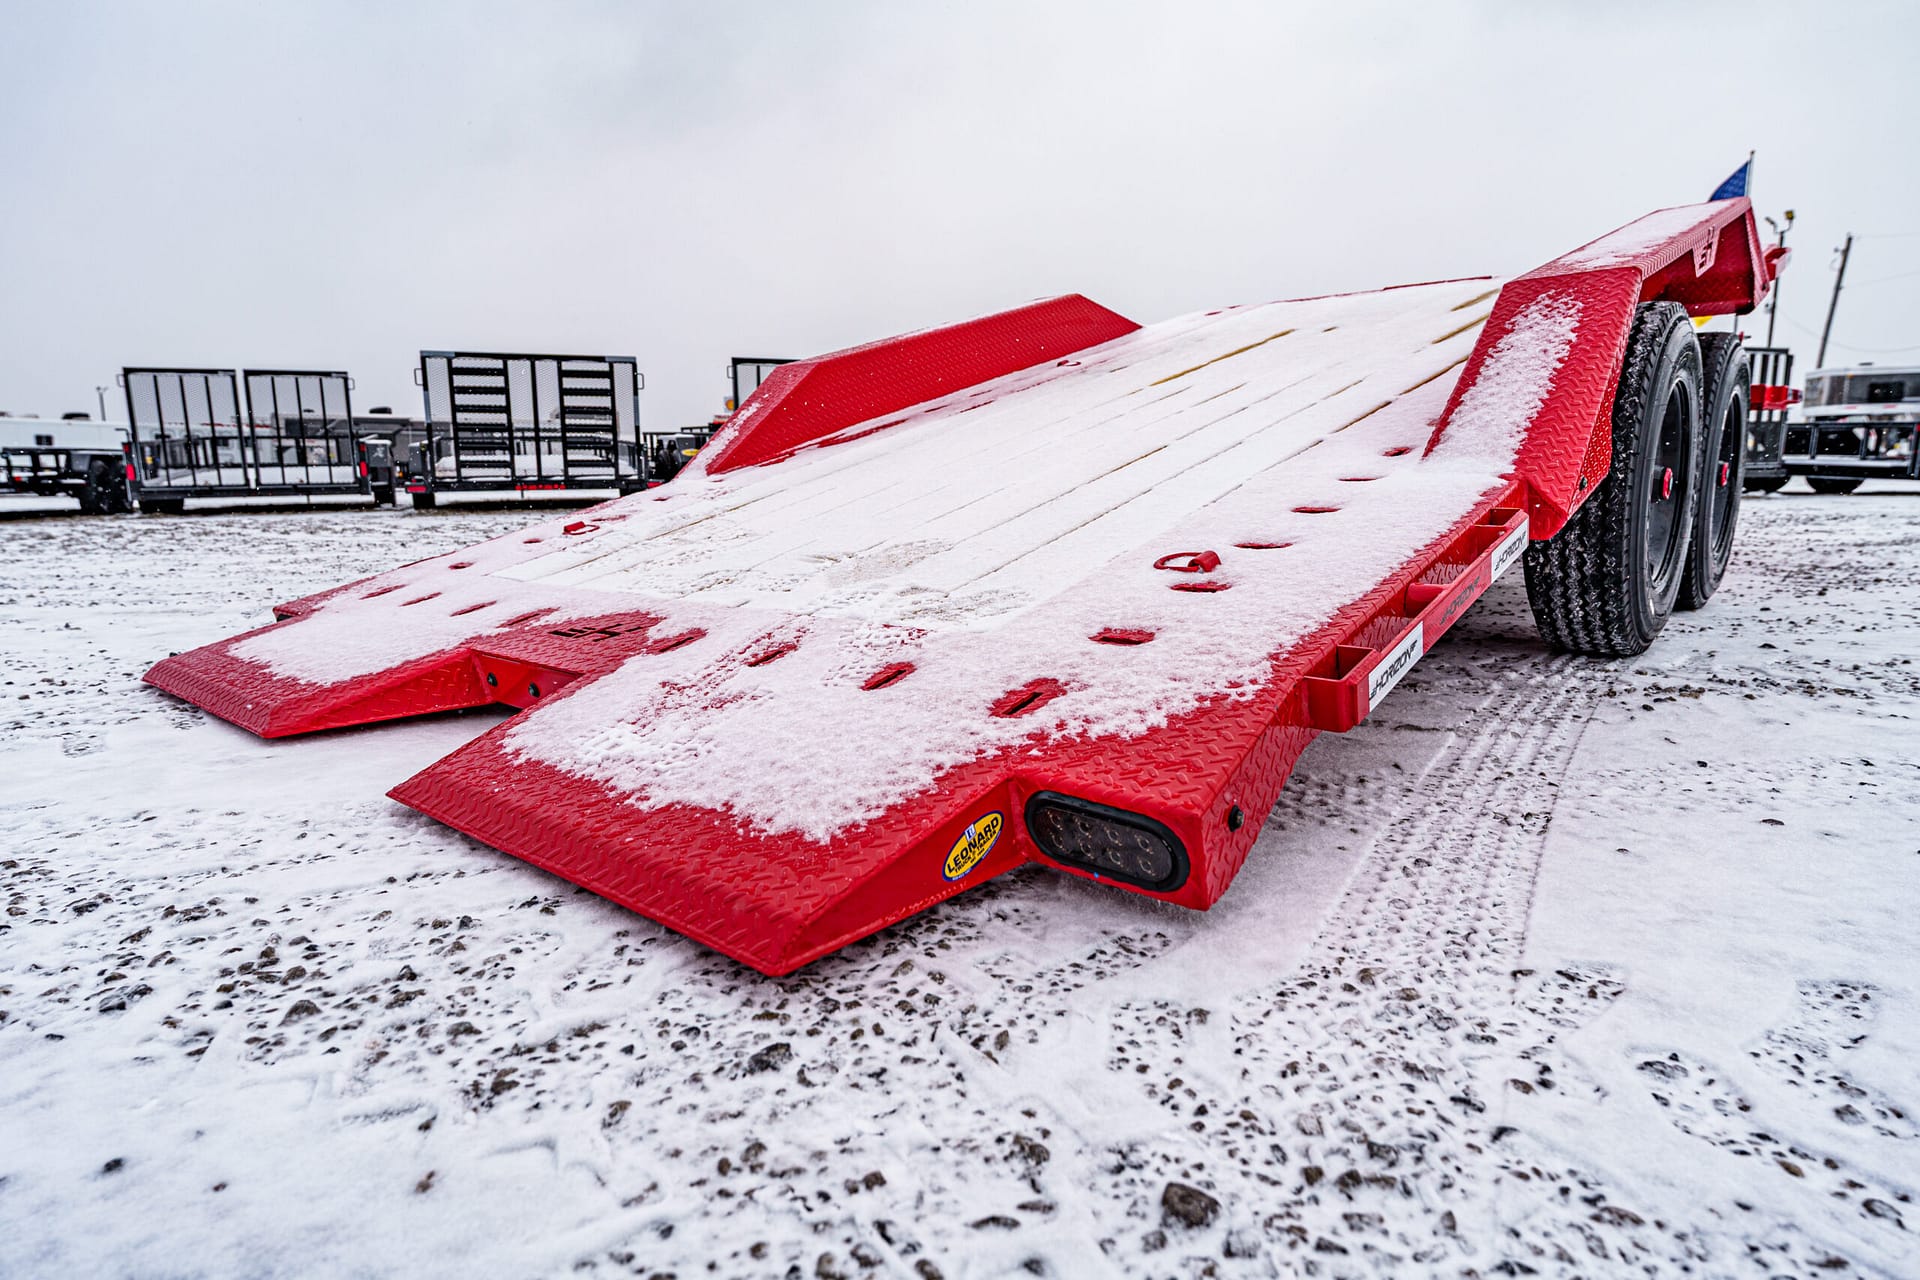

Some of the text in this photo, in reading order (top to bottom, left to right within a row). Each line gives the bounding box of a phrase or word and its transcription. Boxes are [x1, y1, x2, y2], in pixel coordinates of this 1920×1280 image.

[947, 816, 999, 874] LEONARD
[954, 854, 973, 873] TRUCK
[977, 829, 997, 851] TRAILER
